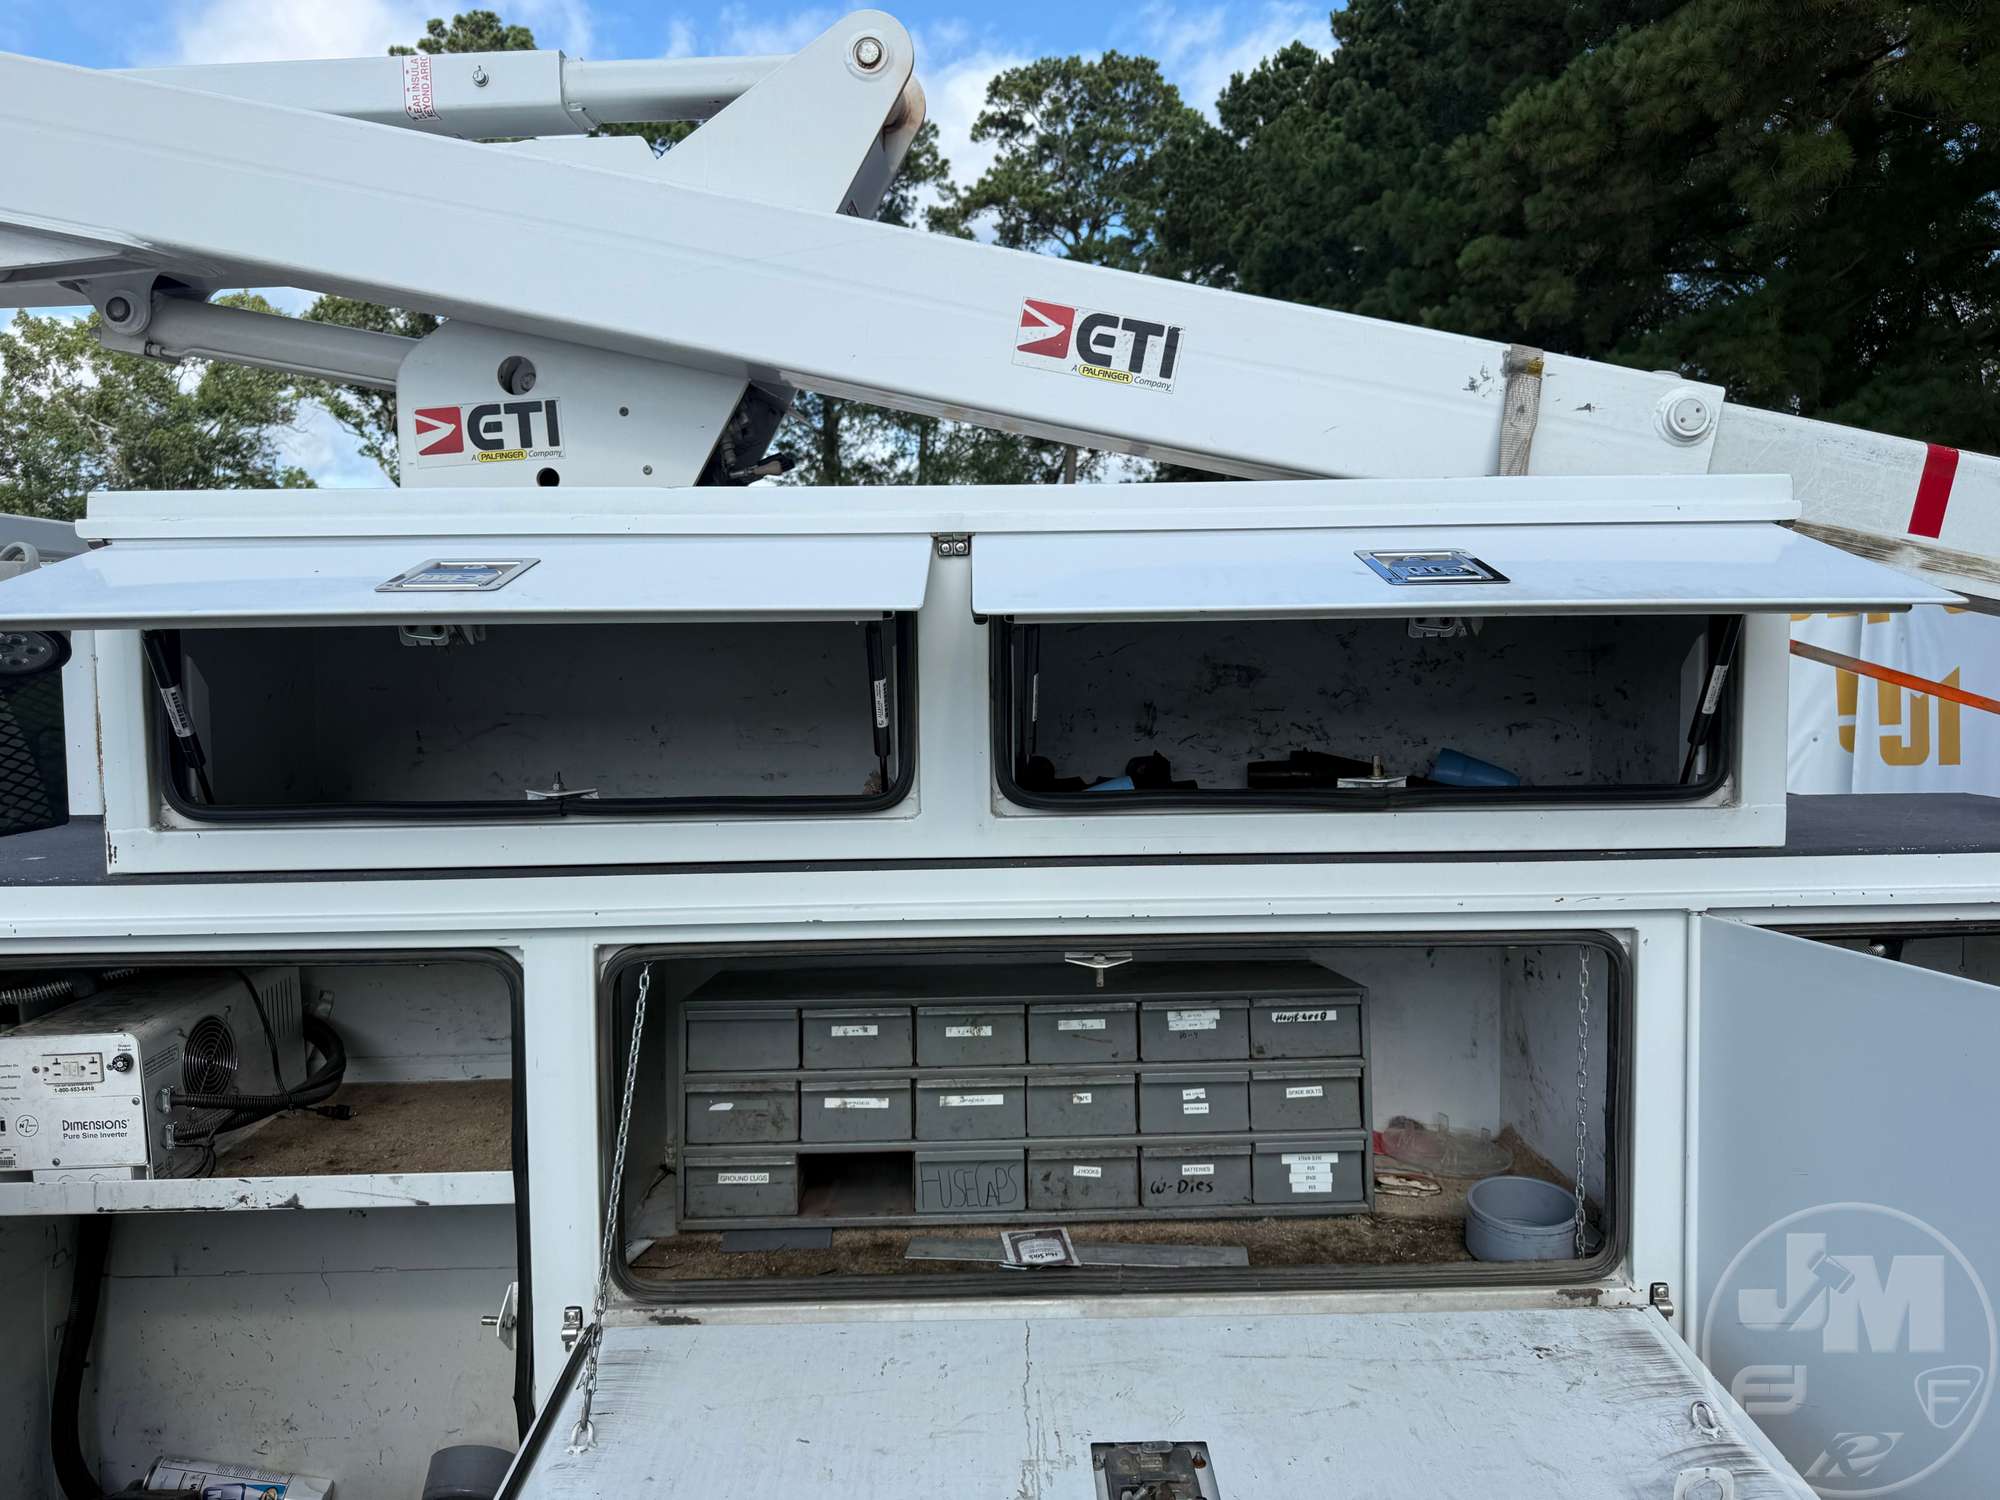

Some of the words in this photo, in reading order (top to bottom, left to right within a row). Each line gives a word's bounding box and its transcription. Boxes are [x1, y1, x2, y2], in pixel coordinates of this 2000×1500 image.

[1076, 312, 1180, 380] ETI
[1071, 364, 1078, 372] A
[1081, 366, 1130, 382] PALFINGER
[1133, 376, 1172, 392] Company
[467, 399, 561, 451] ETI
[480, 451, 524, 462] PALFINGER
[528, 449, 563, 459] Company
